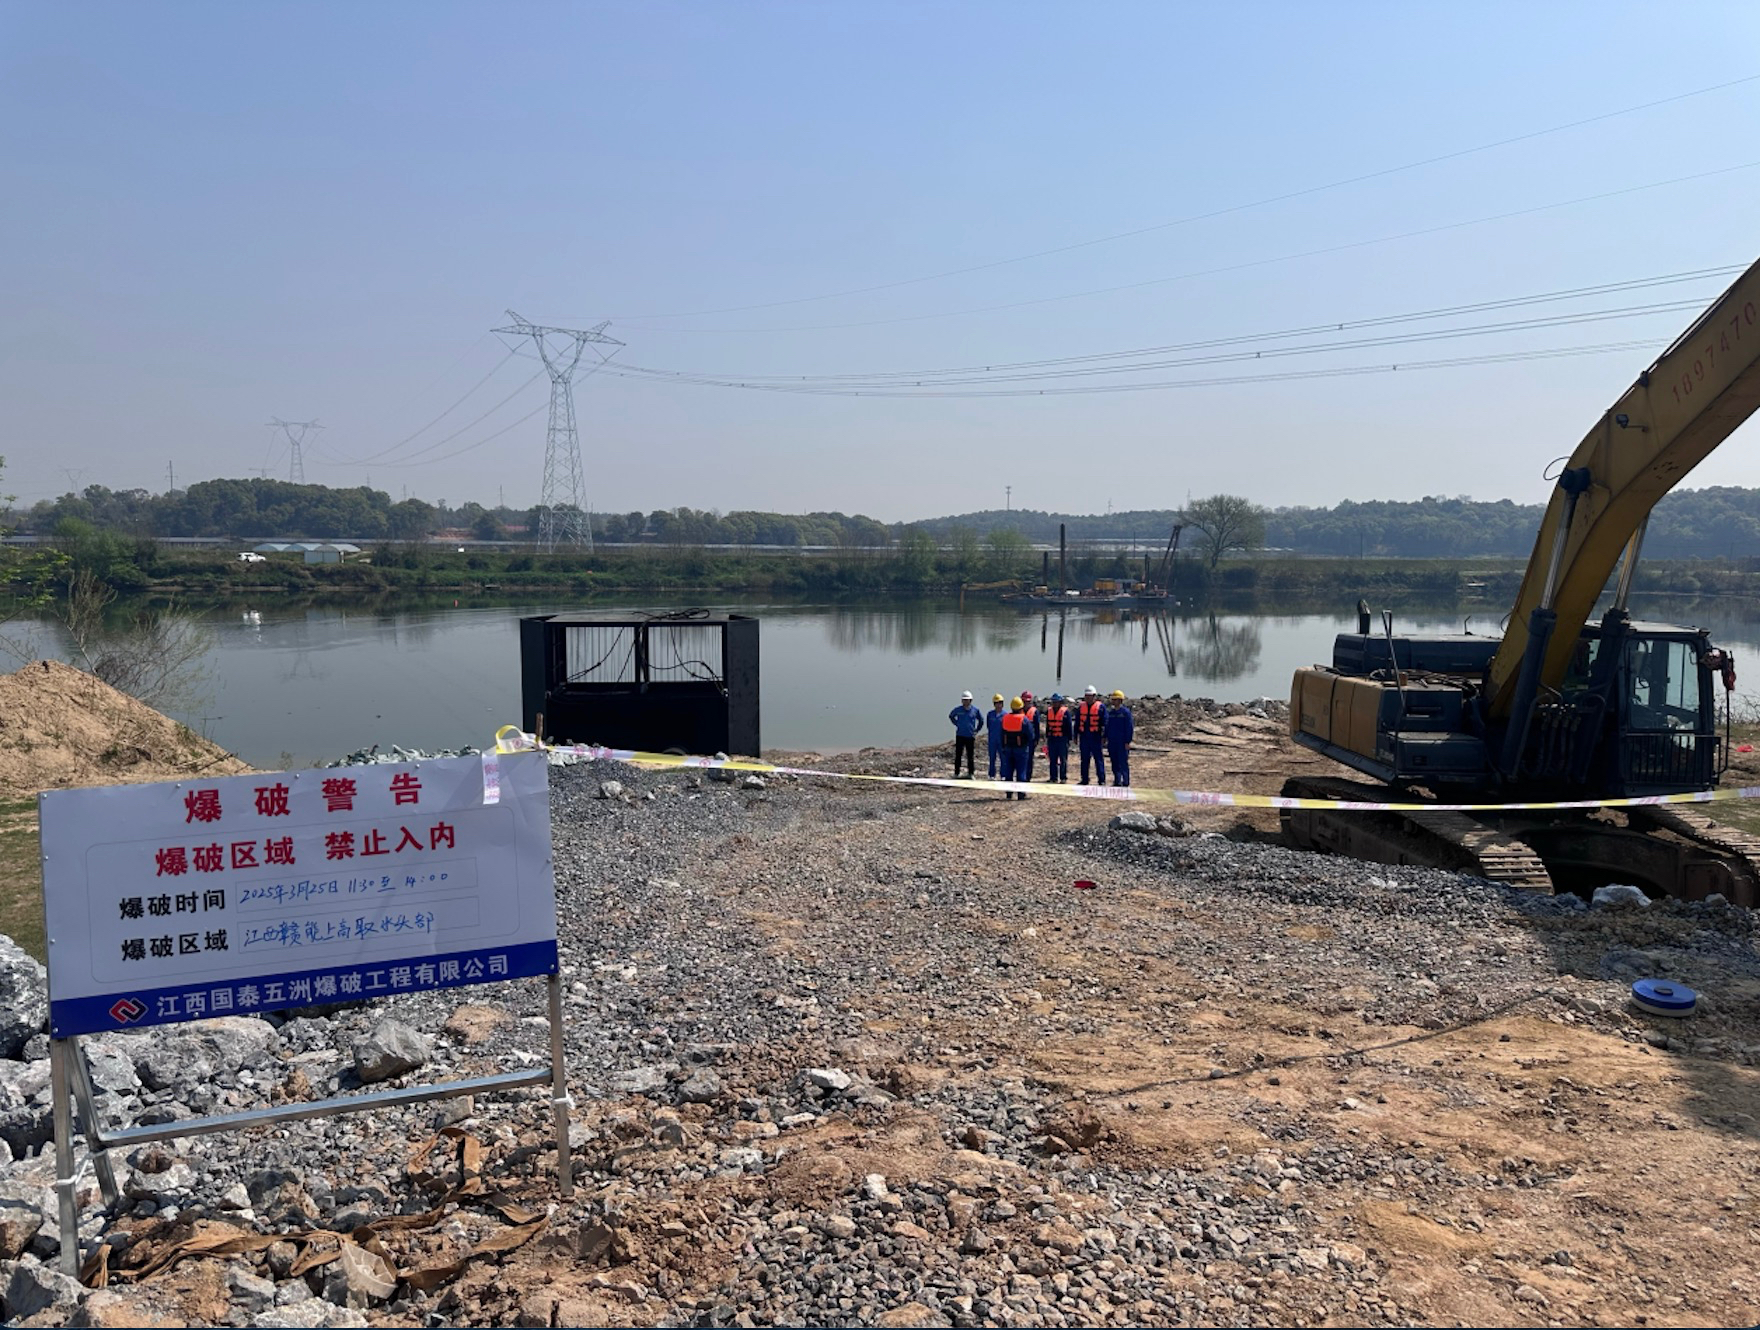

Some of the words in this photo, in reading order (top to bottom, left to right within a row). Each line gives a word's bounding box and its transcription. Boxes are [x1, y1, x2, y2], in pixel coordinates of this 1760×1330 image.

[183, 772, 423, 824] 爆破警告
[155, 836, 296, 877] 爆破区域
[325, 821, 456, 861] 禁止入内
[119, 888, 226, 920] 爆破时间
[120, 928, 229, 962] 爆破区域
[156, 953, 510, 1019] 江西国泰五洲爆破工程有限公司
